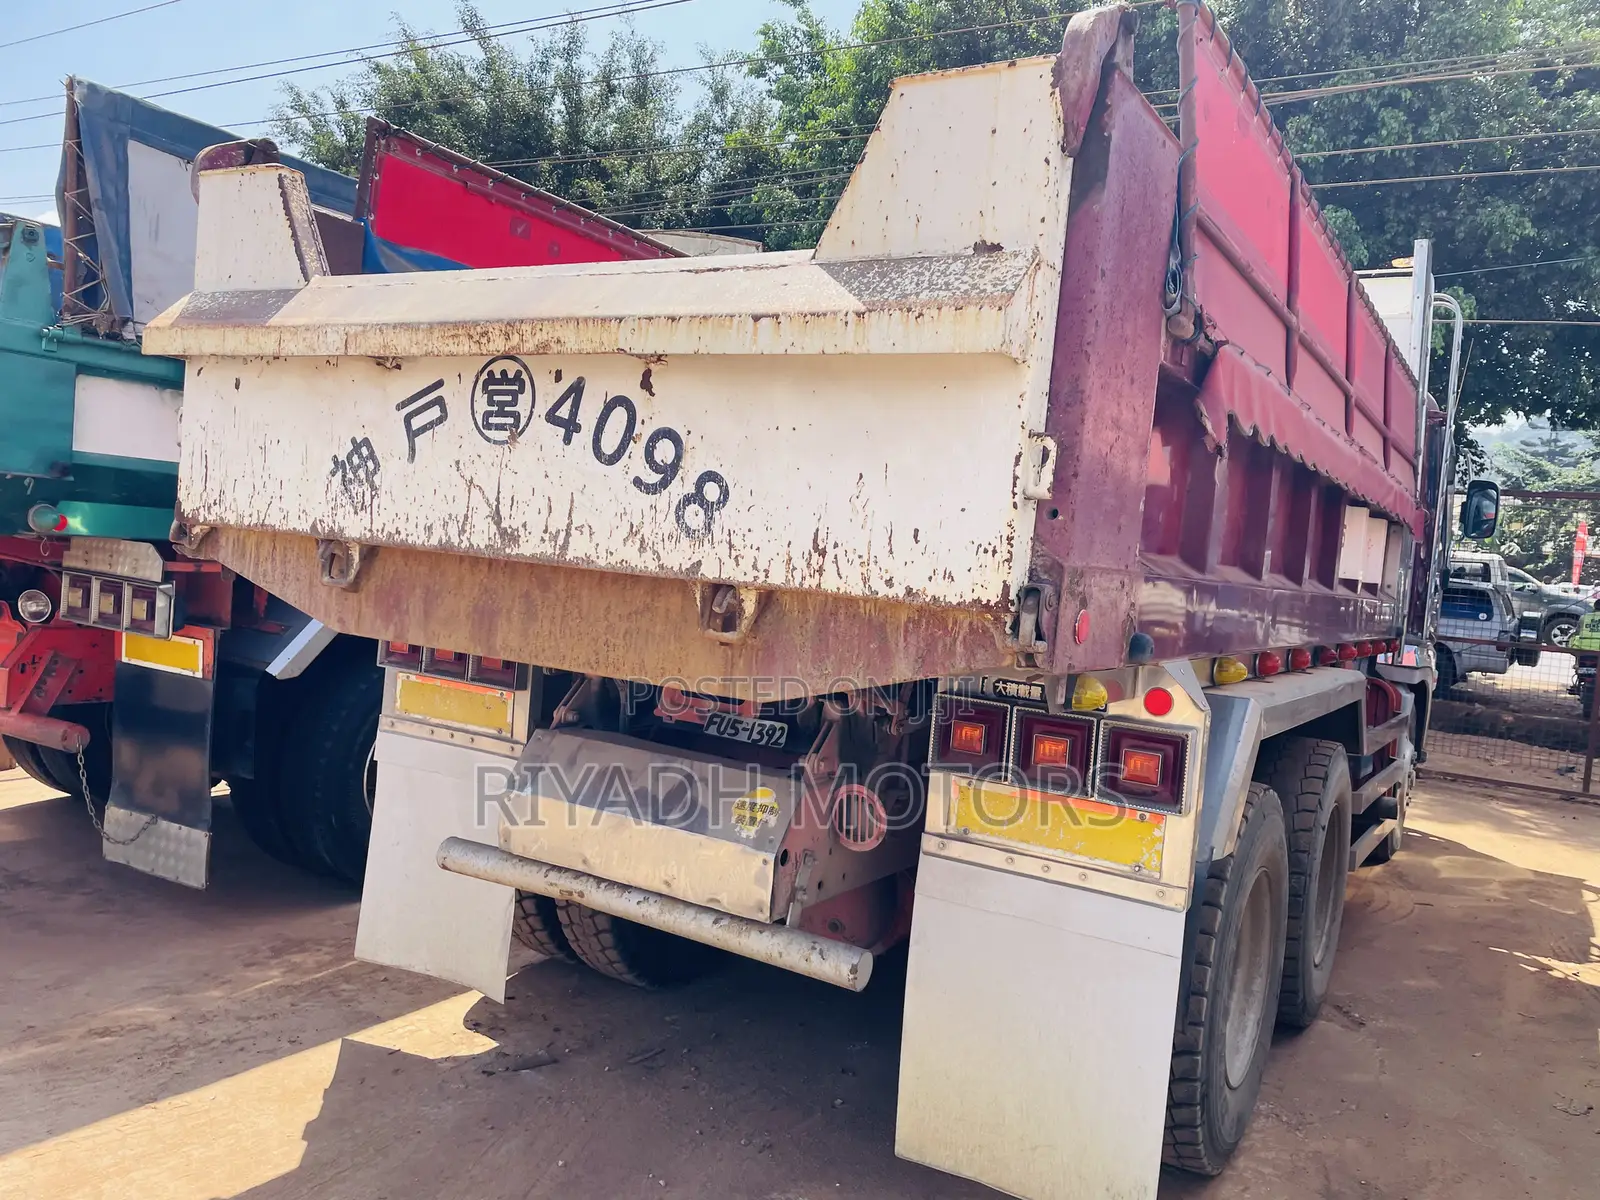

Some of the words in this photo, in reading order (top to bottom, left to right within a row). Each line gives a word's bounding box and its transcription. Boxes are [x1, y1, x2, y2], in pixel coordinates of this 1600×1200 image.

[545, 376, 730, 540] 4098
[983, 679, 1043, 701] 大積載量
